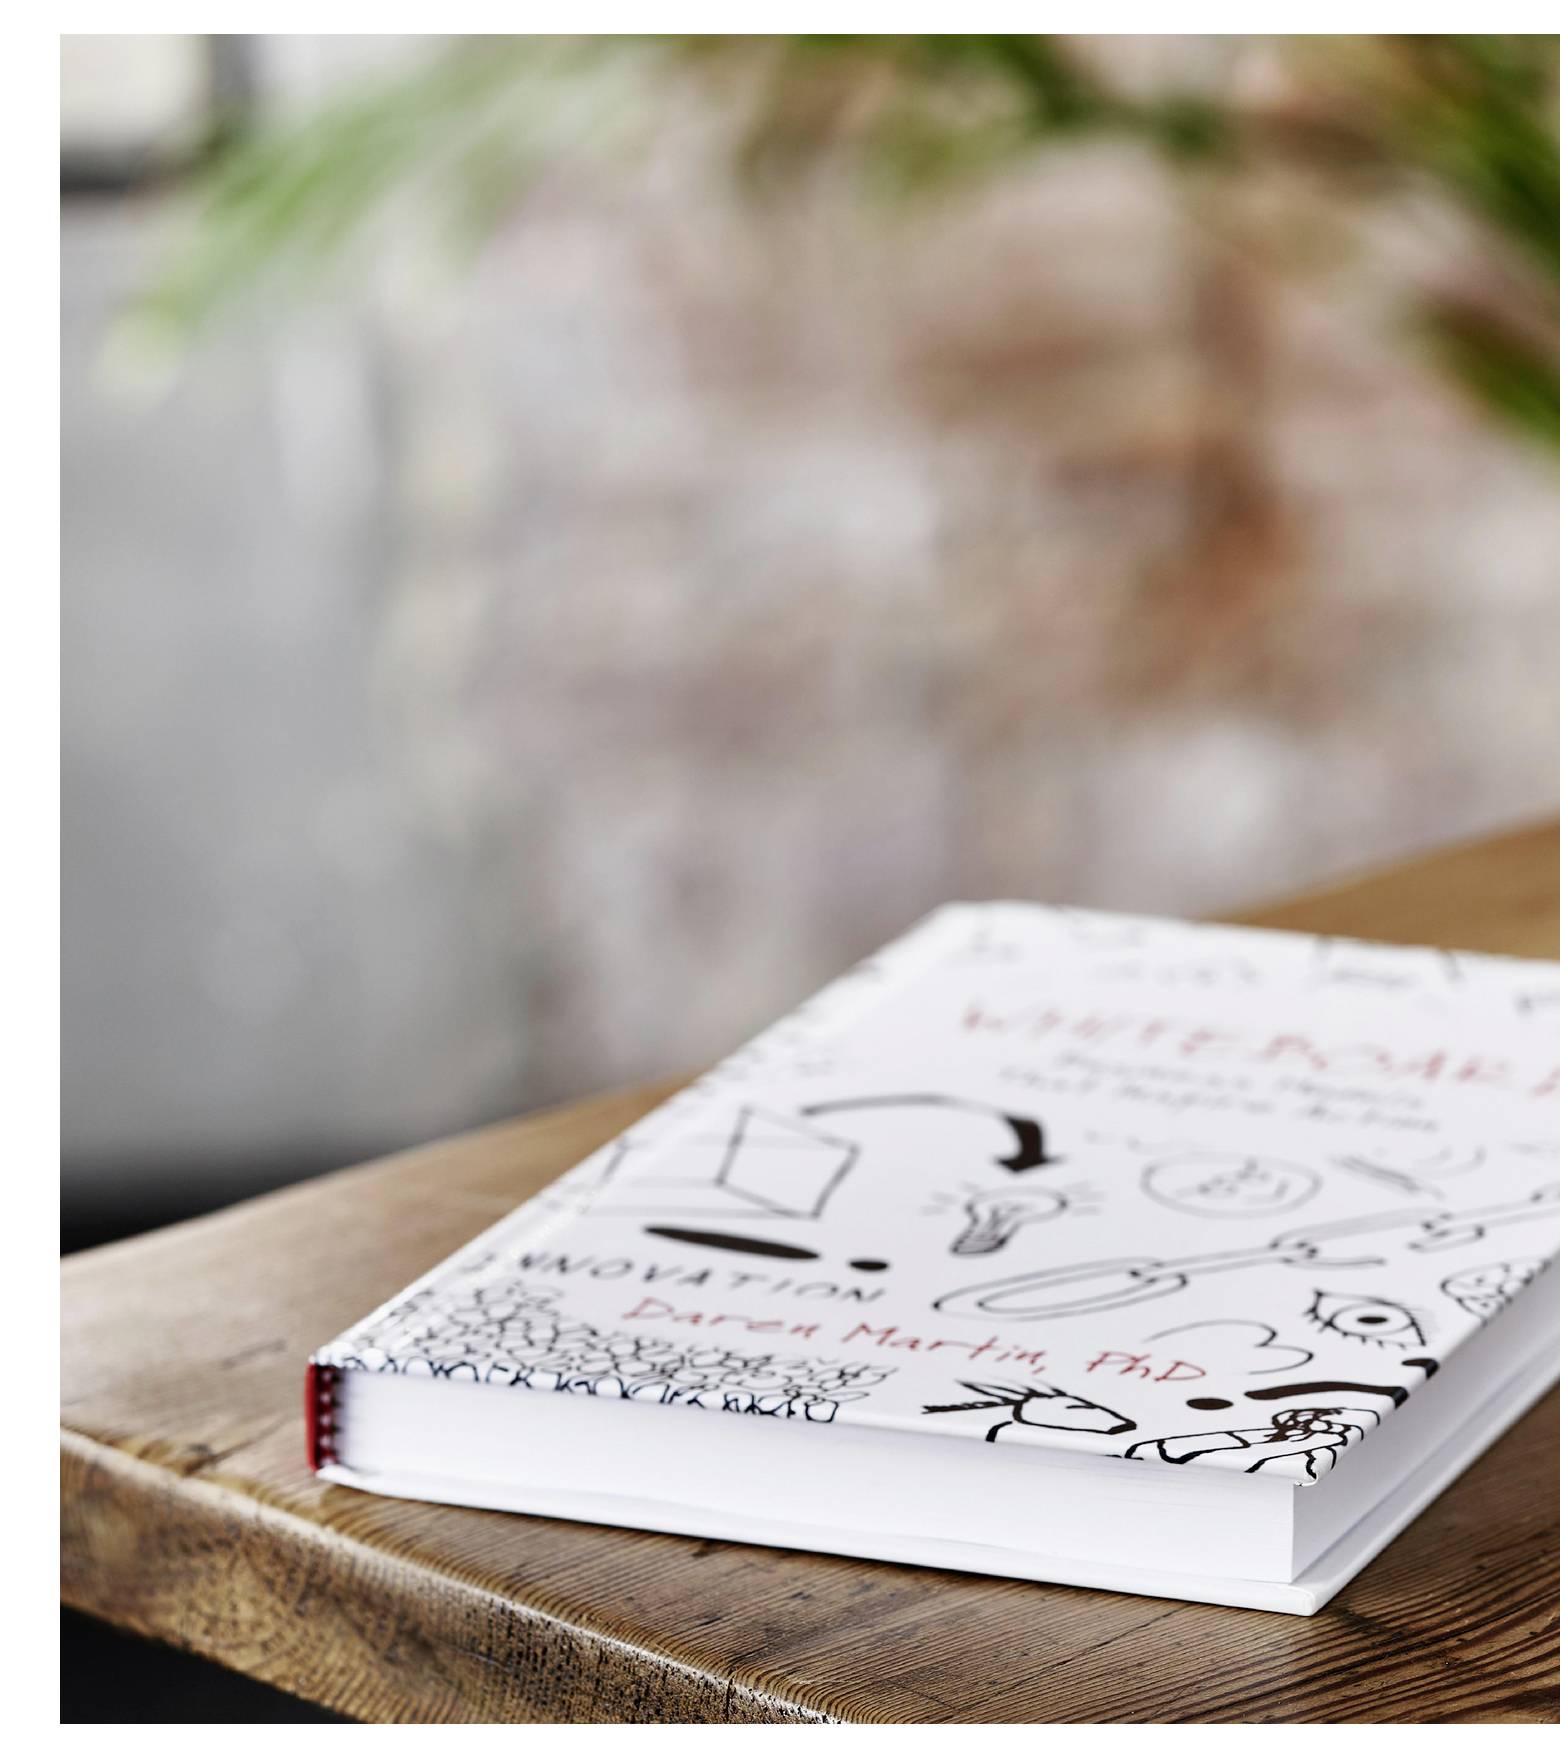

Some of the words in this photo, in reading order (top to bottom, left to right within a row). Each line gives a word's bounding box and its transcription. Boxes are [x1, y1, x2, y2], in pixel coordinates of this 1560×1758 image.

[621, 1297, 820, 1339] Daren
[840, 1320, 1047, 1375] Martin,
[1085, 1349, 1207, 1383] PhD
